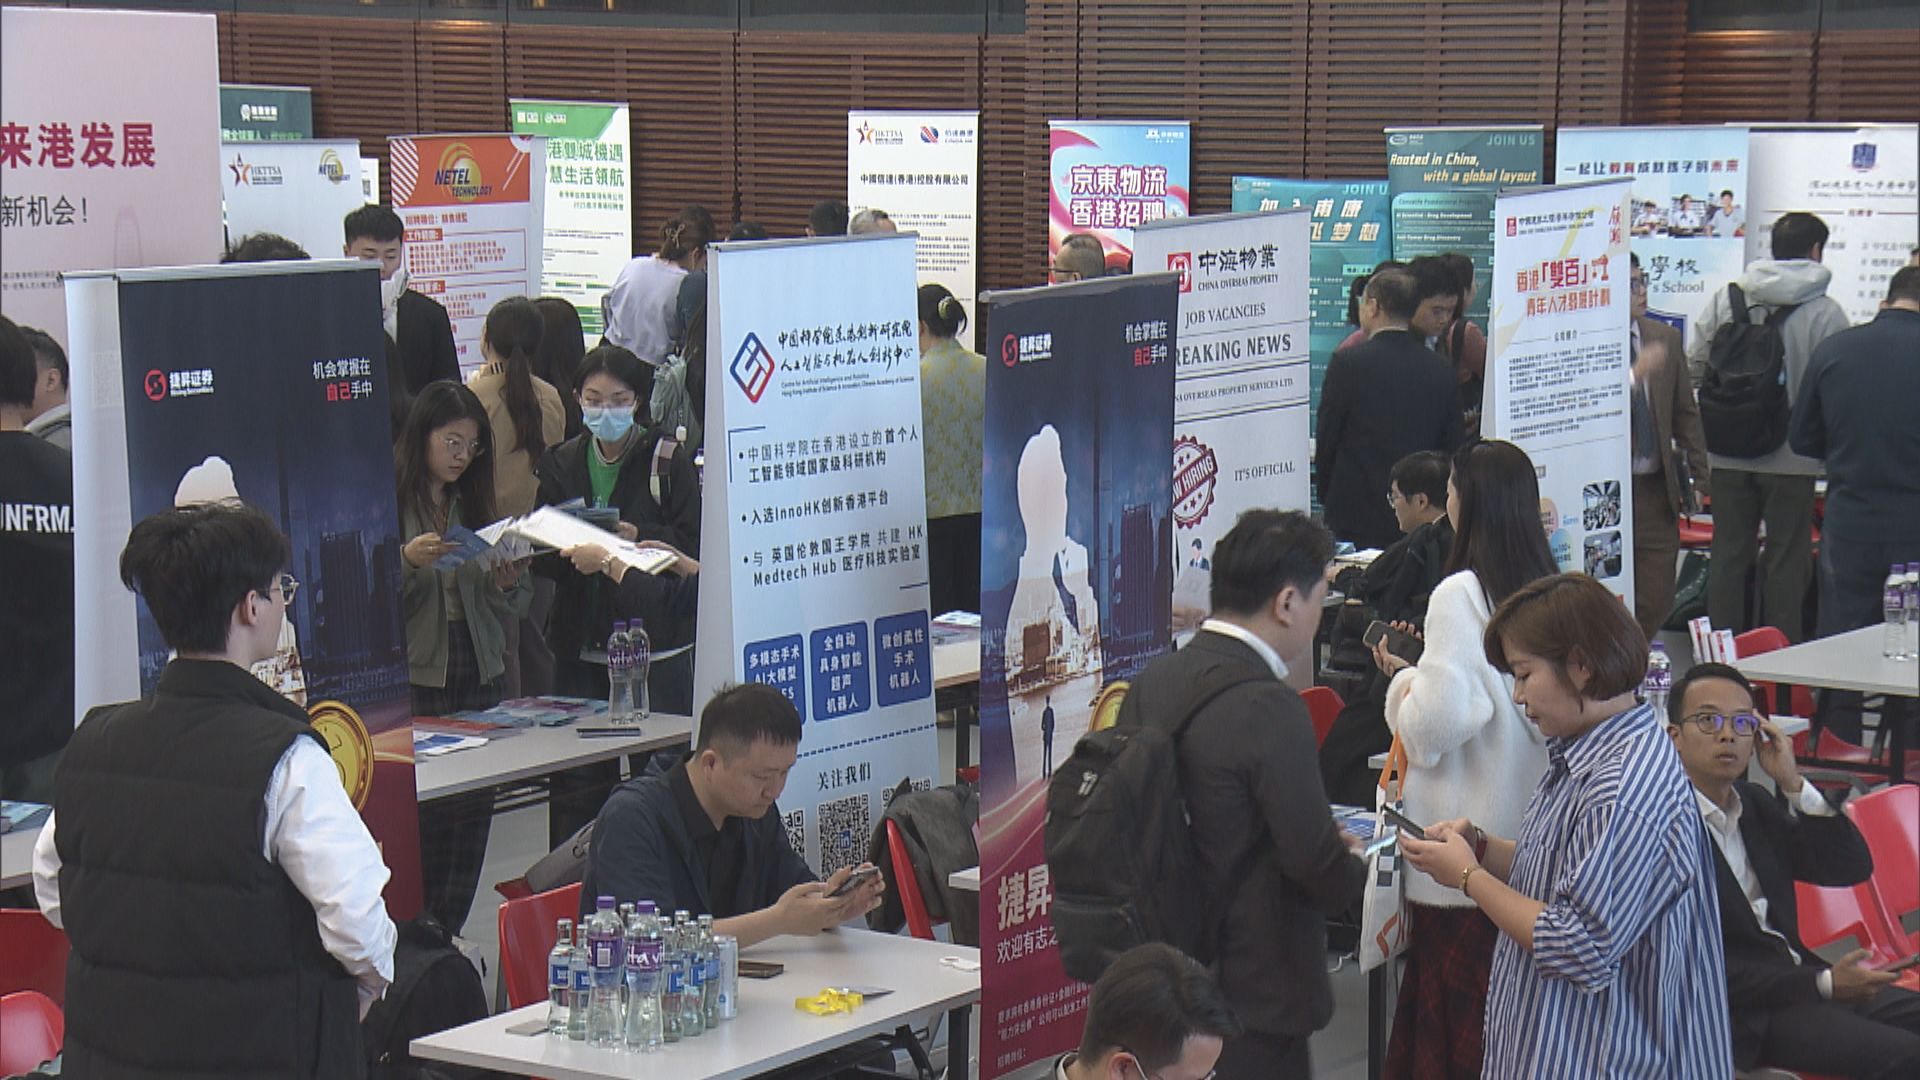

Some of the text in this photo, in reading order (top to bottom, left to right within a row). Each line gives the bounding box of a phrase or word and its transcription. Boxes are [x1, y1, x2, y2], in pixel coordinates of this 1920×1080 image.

[0, 122, 156, 169] 来港发展
[1486, 134, 1536, 146] JOIN US
[1390, 152, 1480, 167] Rooted in China,
[434, 168, 471, 185] NETEL
[1071, 165, 1167, 196] 京東物流
[1423, 168, 1537, 184] with a global layout
[452, 185, 493, 197] TECHNOLOGY
[1342, 183, 1389, 196] JOIN U
[1071, 199, 1166, 228] 香港招聘
[1198, 274, 1278, 291] CHINA OVERSEAS PROPERTY
[1661, 280, 1705, 293] School
[1185, 302, 1266, 328] JOB VACANCIES
[1125, 320, 1167, 343] 机会掌握在
[1134, 344, 1167, 367] 自己手中
[1247, 333, 1291, 358] NEWS
[313, 358, 371, 379] 机会掌握在
[326, 380, 373, 402] 自己手中
[1184, 389, 1217, 400] OVERSEAS
[1218, 383, 1248, 397] PROPERTY
[748, 424, 918, 462] 中国科学院在香港设立的首个人
[749, 450, 886, 484] 工智能领域国家级科研机构
[1182, 455, 1214, 491] HIRING
[0, 503, 75, 533] NFRM.
[751, 489, 889, 525] 入选InnoHK创新香港平台
[908, 525, 923, 540] HK
[754, 545, 921, 587] Medtech Hub 医疗科技实验室
[823, 632, 856, 652] 全自动
[749, 643, 800, 669] 多模态手术
[819, 651, 863, 673] 具身智能
[893, 650, 915, 666] 手术
[831, 674, 851, 692] 超声
[889, 670, 921, 690] 机器人
[826, 693, 859, 713] 机器人
[817, 761, 871, 792] 关注我们
[998, 863, 1052, 931] 捷昇
